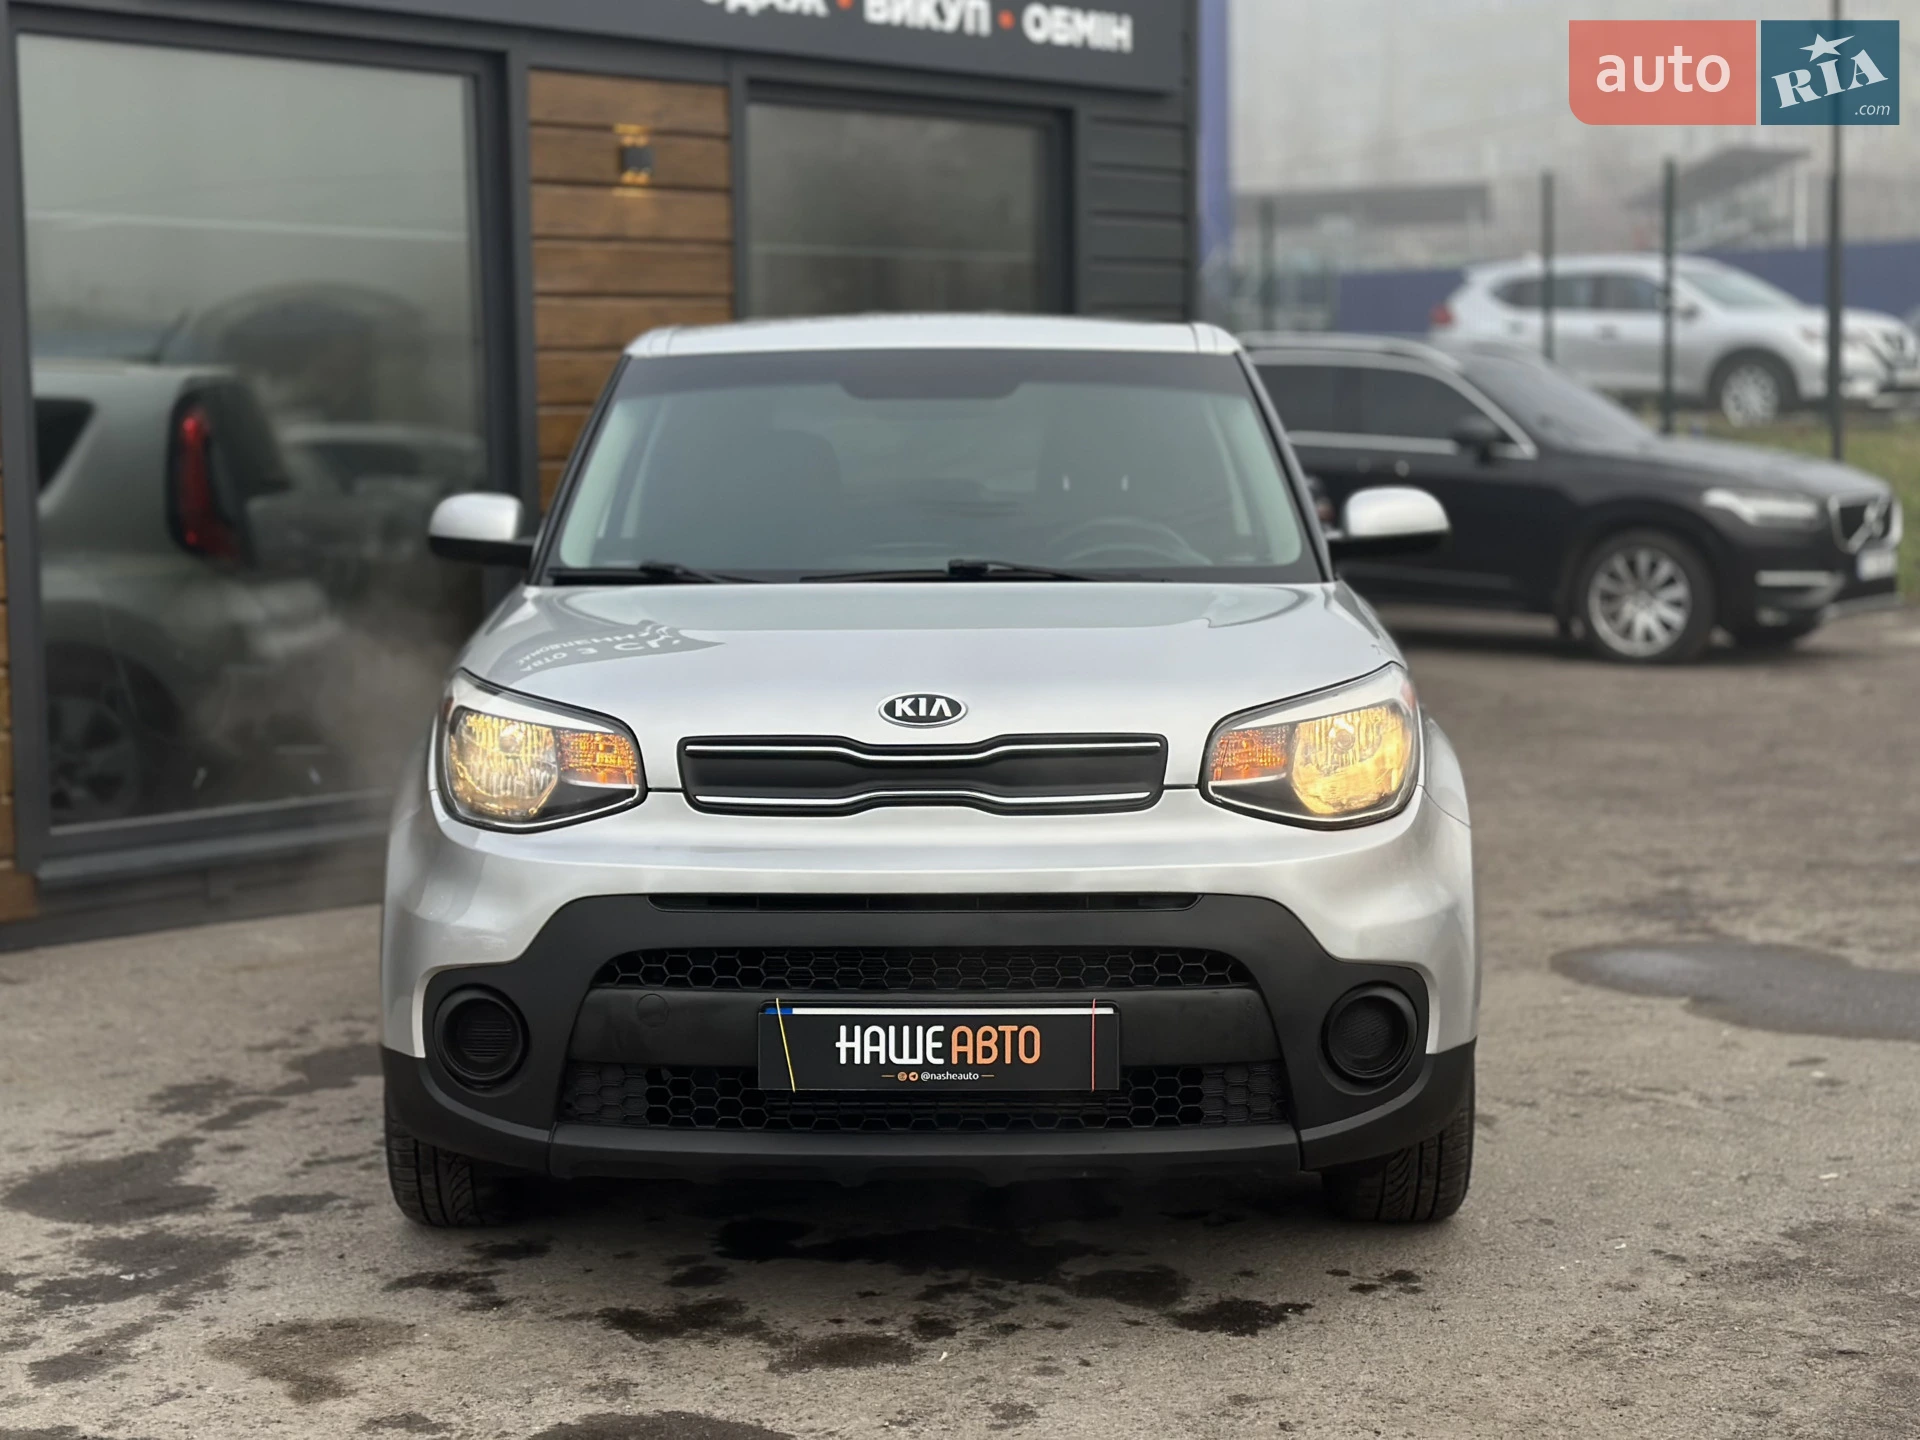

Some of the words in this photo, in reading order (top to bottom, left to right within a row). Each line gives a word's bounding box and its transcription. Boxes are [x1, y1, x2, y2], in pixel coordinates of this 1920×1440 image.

[863, 0, 992, 37] ВИКУП
[1021, 2, 1134, 53] ОБМІН
[894, 697, 952, 718] KIA
[835, 1025, 945, 1065] НАШЕ
[951, 1025, 1041, 1065] АВТО
[920, 1071, 979, 1082] @nasheauto
